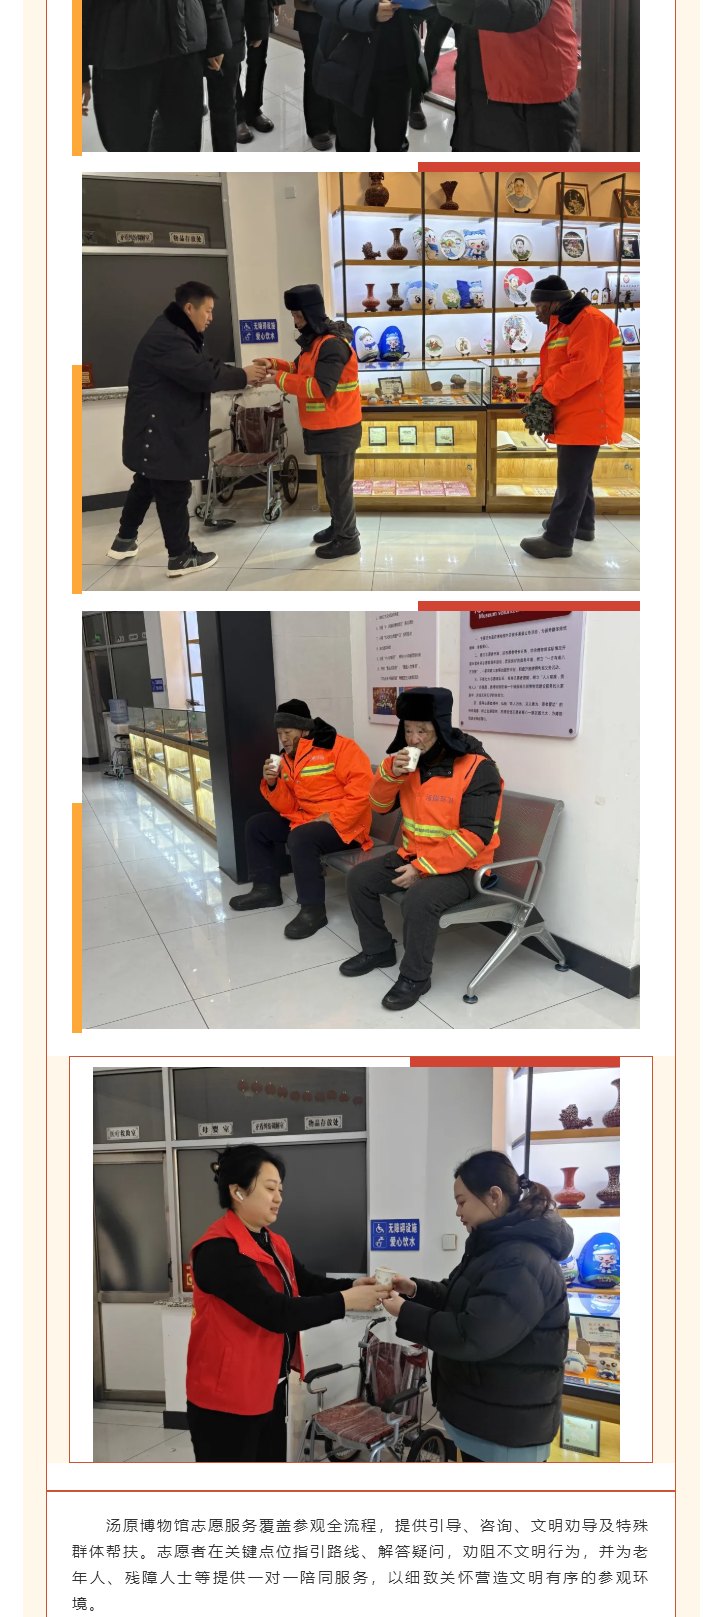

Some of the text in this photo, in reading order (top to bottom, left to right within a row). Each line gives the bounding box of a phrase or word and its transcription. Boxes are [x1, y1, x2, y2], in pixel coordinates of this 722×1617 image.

[388, 1222, 418, 1234] 无障碍设施
[389, 1236, 416, 1248] 爱心饮水
[72, 1596, 96, 1612] 境。
